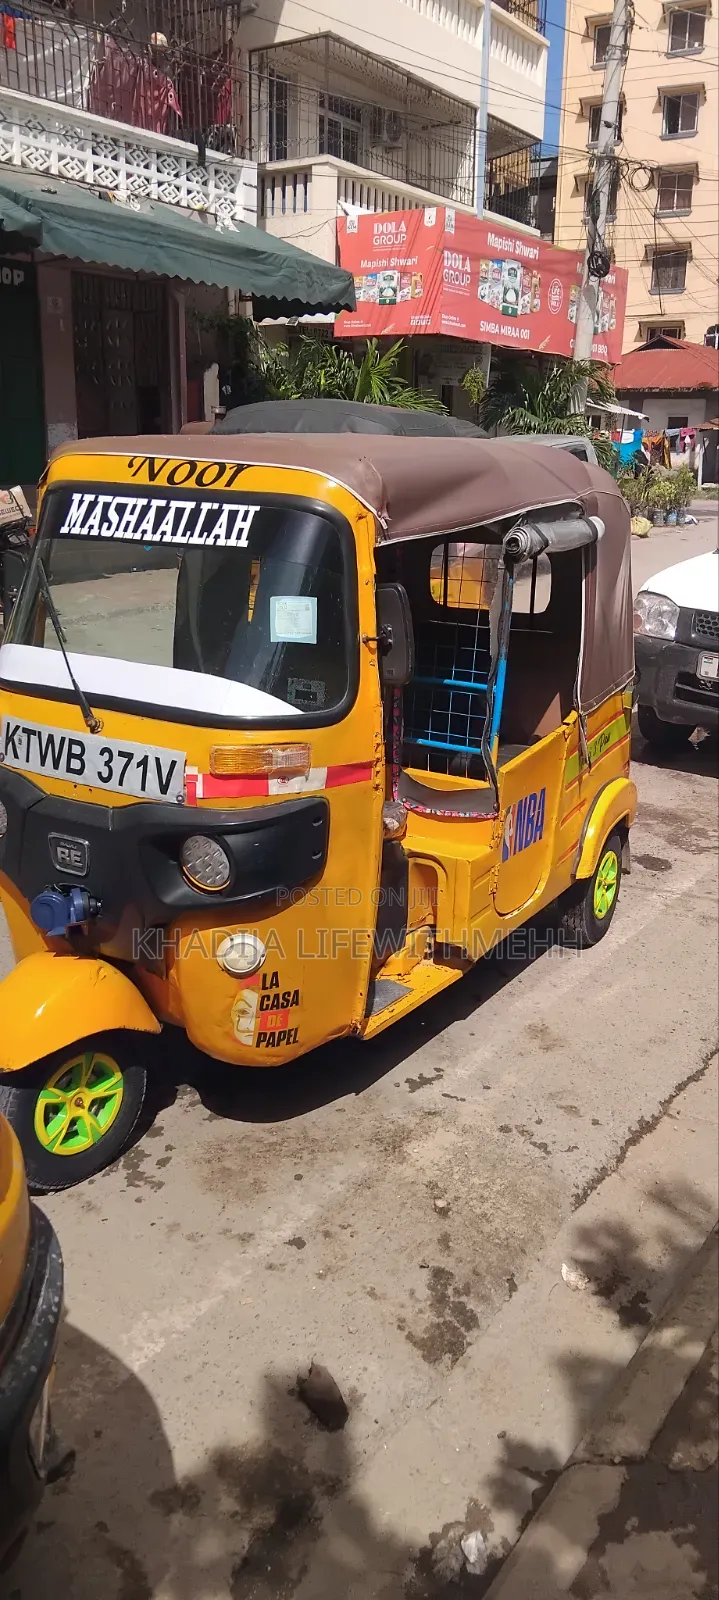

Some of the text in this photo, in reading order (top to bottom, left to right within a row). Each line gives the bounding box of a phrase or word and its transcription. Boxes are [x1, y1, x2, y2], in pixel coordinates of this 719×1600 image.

[373, 221, 407, 234] DOLA
[373, 234, 407, 245] GROUP
[488, 232, 540, 260] Mapishi Shwari
[361, 256, 418, 269] Mapishi Shwari
[444, 250, 471, 272] DOLA
[0, 266, 24, 285] OP
[443, 269, 471, 287] GROUP
[480, 321, 500, 334] SIMBA
[500, 325, 520, 338] MIRAA
[520, 329, 530, 340] 001
[127, 456, 252, 488] Noor
[59, 492, 260, 548] MASHAALLAH
[4, 722, 178, 796] KTWB 371V
[513, 787, 546, 856] NBA
[57, 846, 84, 868] RE
[261, 971, 280, 990] LA
[259, 989, 300, 1012] CASA
[266, 1013, 285, 1028] DE
[255, 1027, 299, 1048] PAPEL
